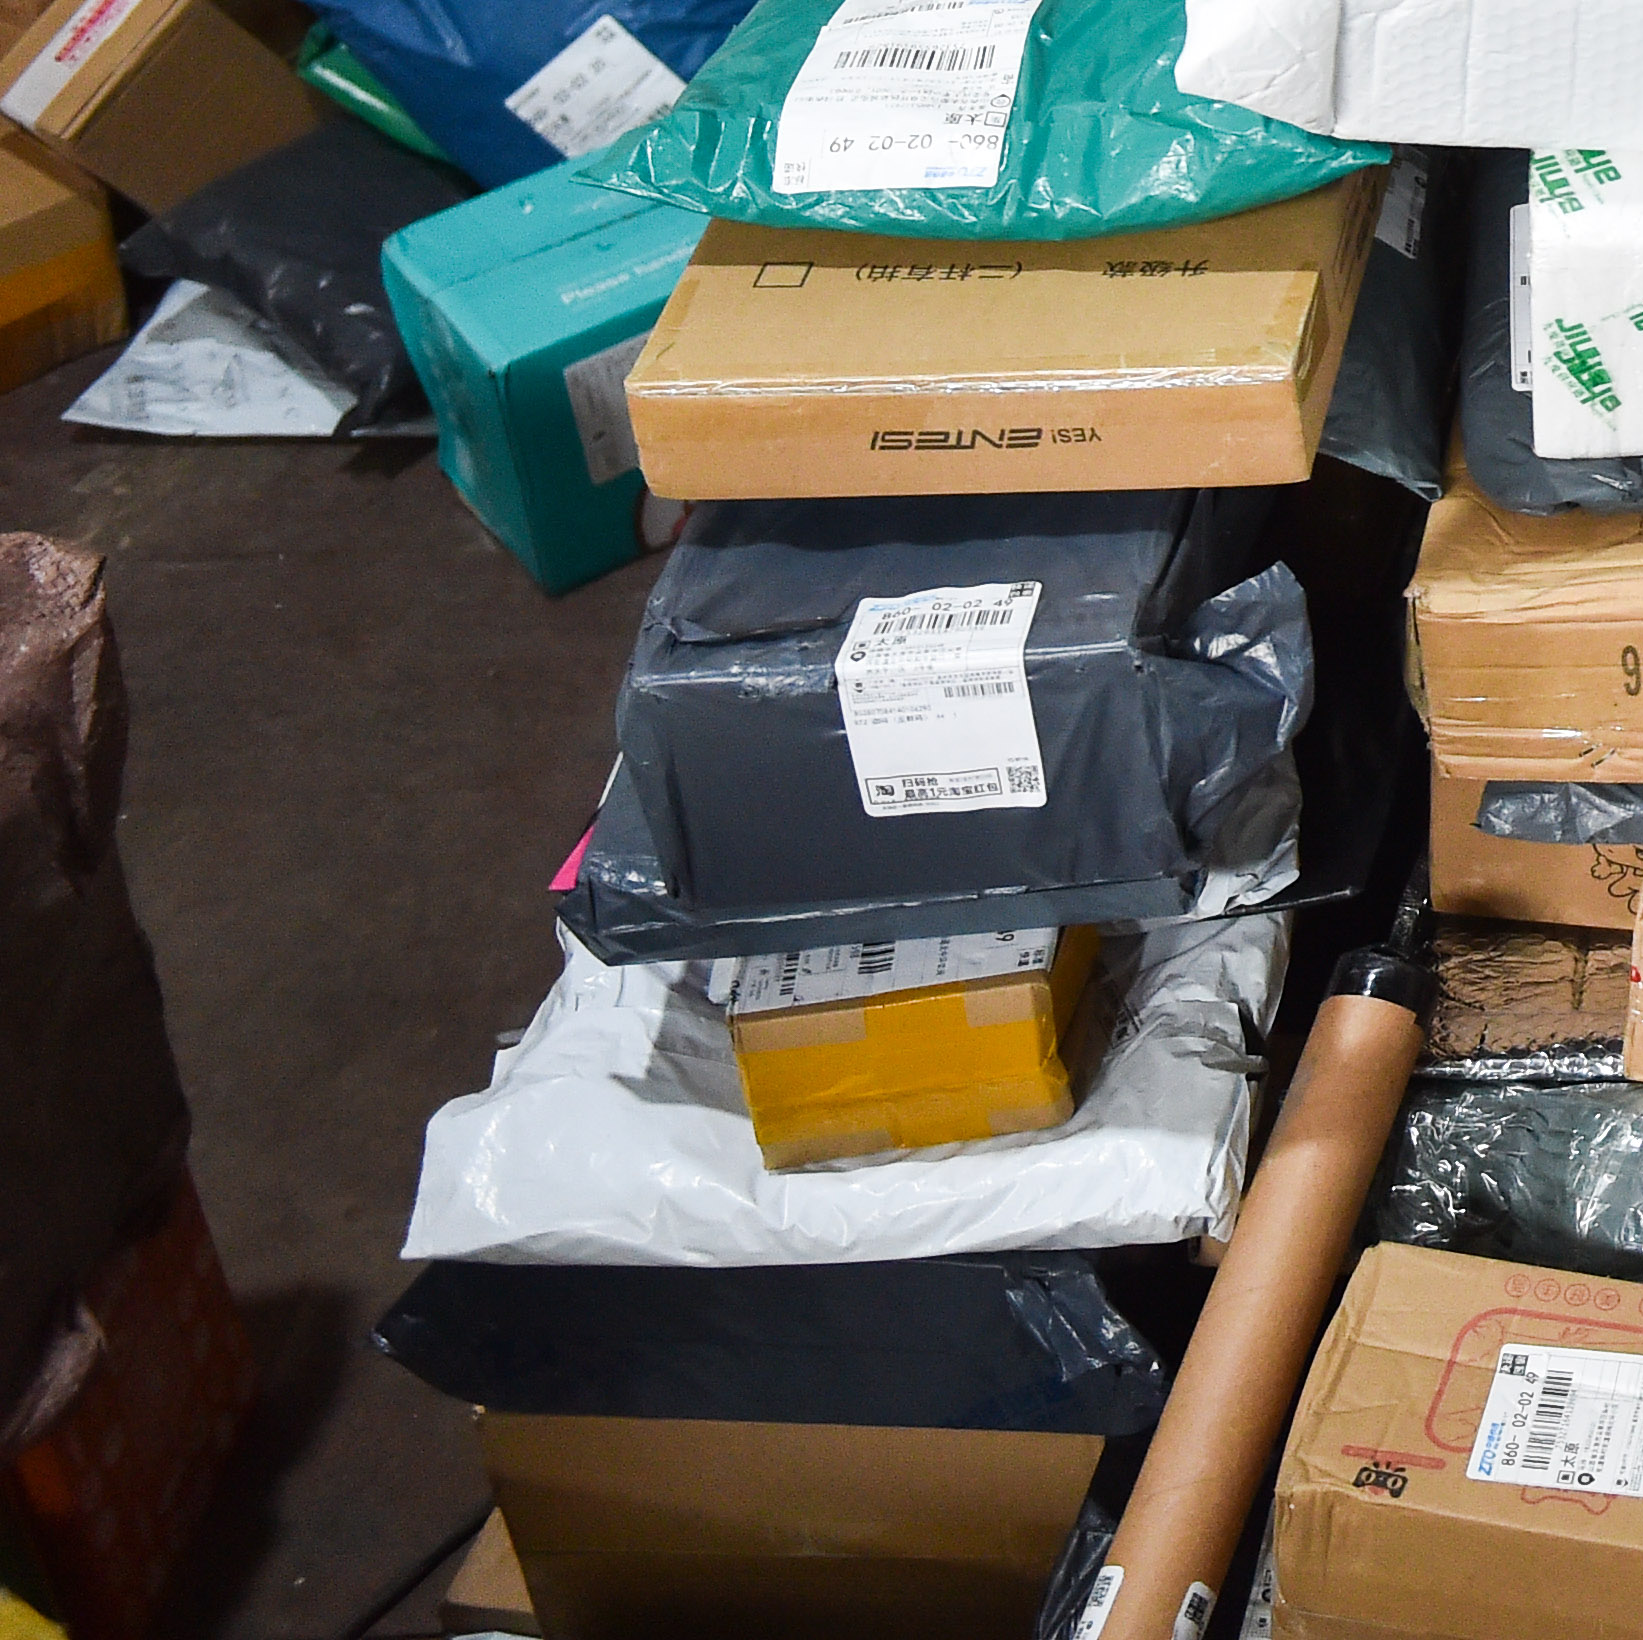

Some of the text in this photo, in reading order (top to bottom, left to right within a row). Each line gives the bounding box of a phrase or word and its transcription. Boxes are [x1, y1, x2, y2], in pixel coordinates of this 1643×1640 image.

[829, 136, 854, 152] 49
[869, 134, 932, 150] 02-02
[1102, 259, 1209, 277] 升级款
[870, 426, 1102, 451] YES! ENTESI
[882, 606, 920, 620] 860-
[932, 599, 982, 612] 02-02
[1501, 1371, 1539, 1466] 860- 02-02 49
[1478, 1450, 1497, 1476] ZTO
[1563, 1442, 1580, 1468] 太原
